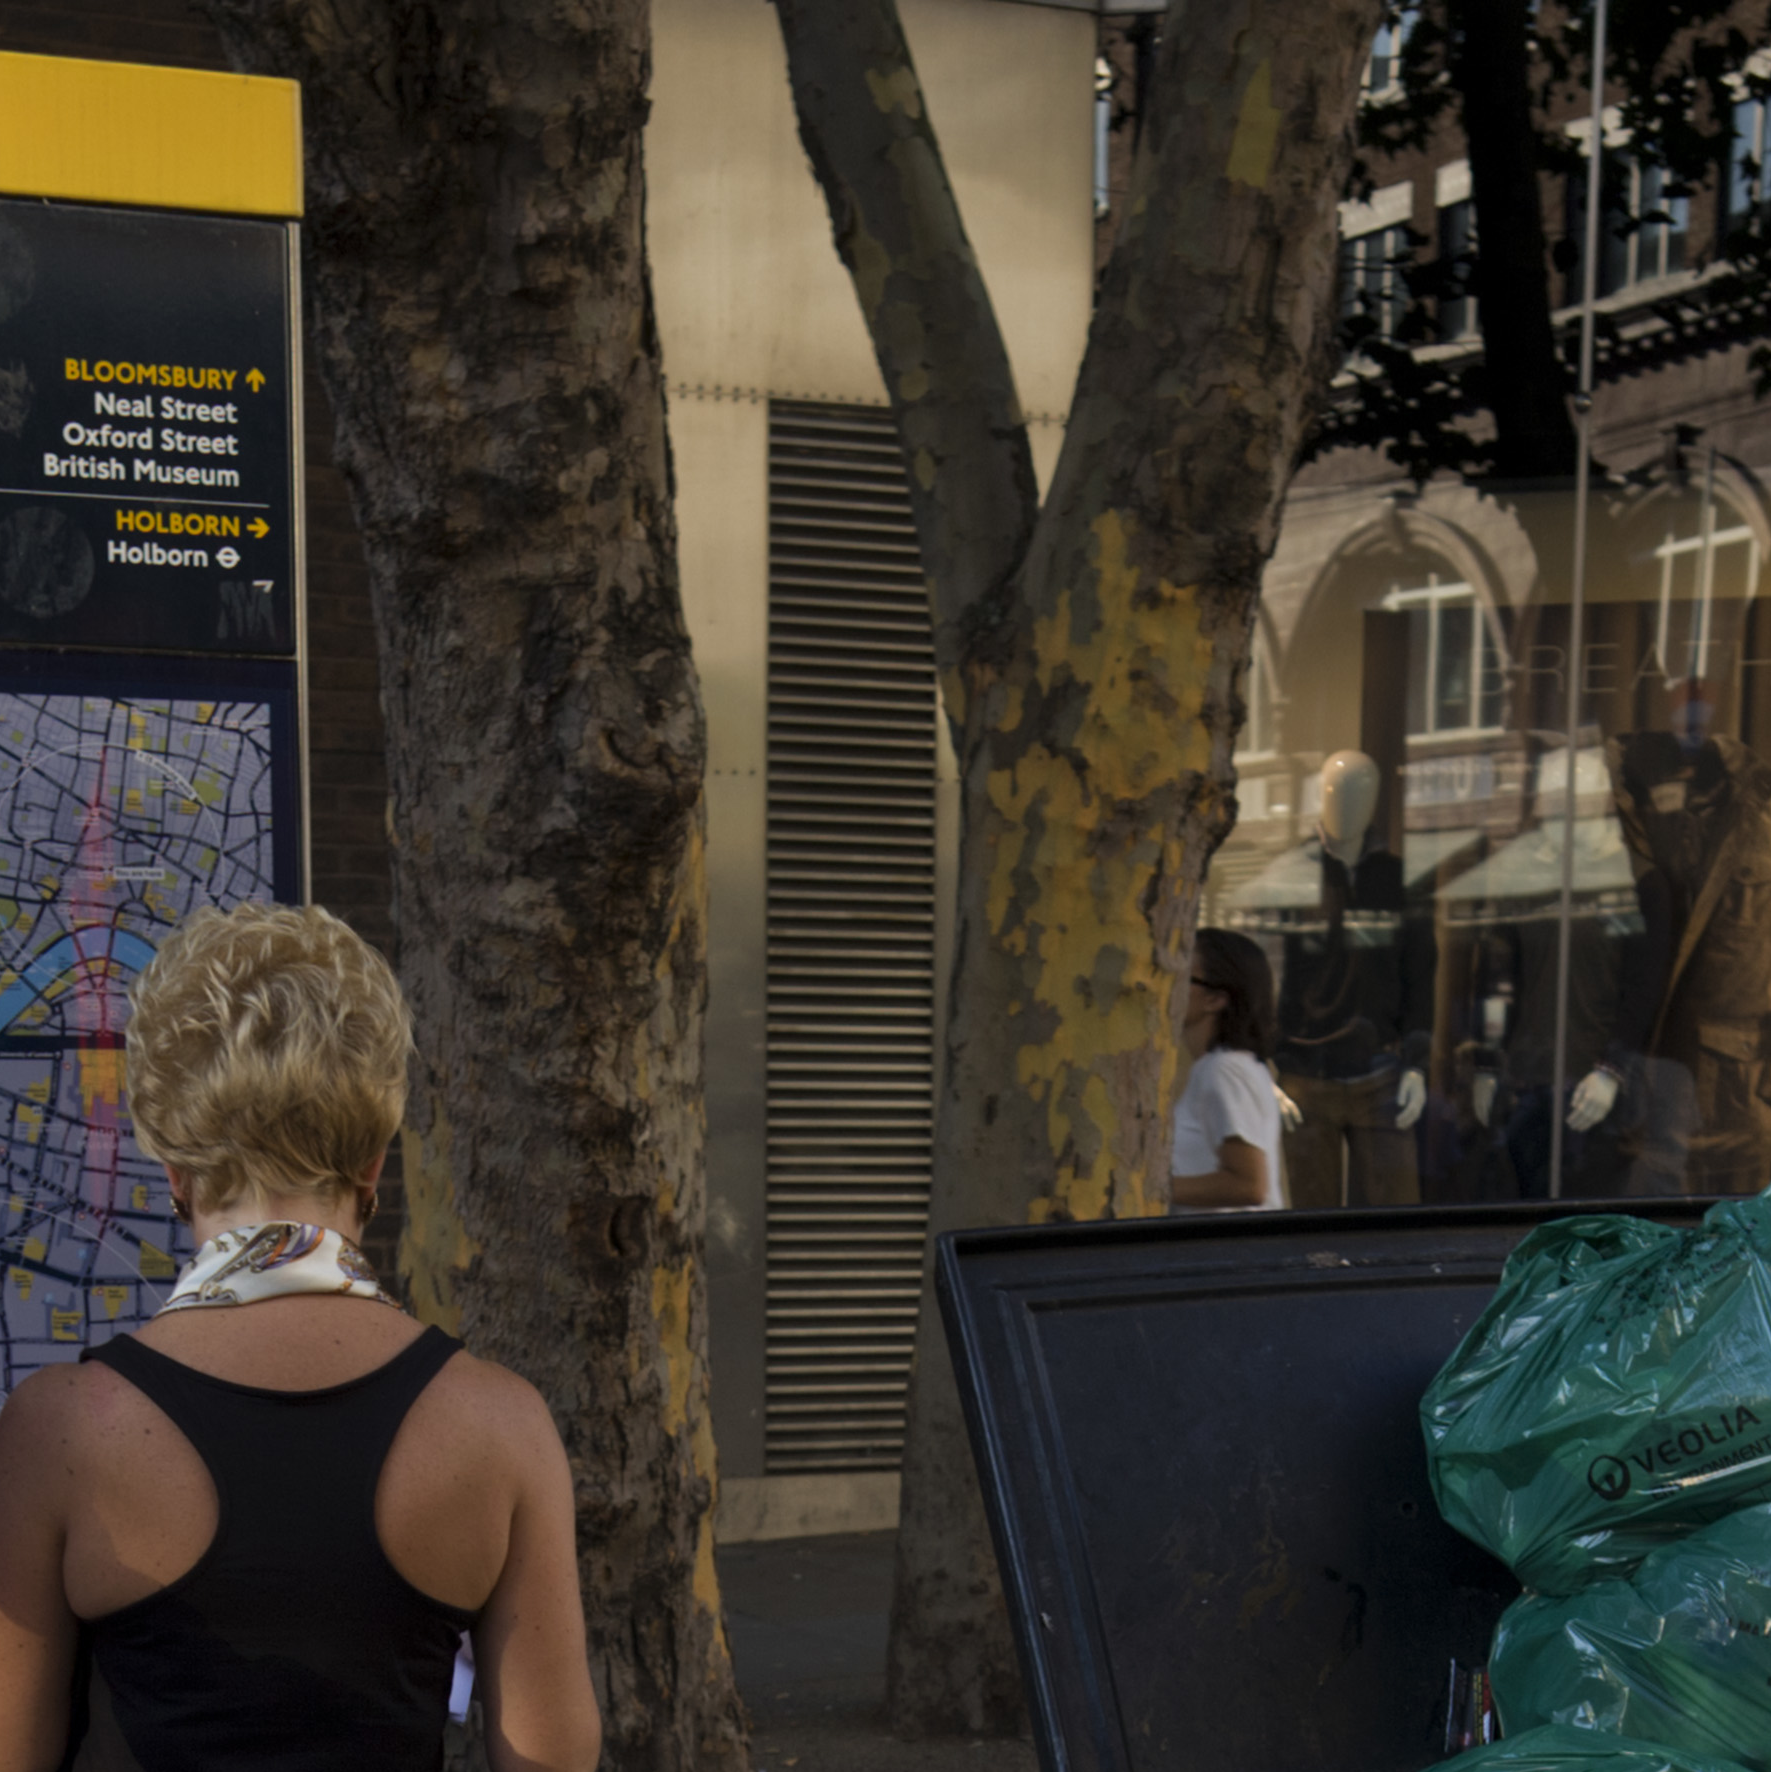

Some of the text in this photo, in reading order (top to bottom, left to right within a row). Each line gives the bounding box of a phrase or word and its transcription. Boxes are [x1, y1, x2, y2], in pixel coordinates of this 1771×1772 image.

[65, 358, 238, 391] BLOOMSBURY
[94, 392, 238, 424] Neal Street
[63, 423, 238, 456] Oxford Street
[44, 453, 240, 488] British Museum
[116, 511, 241, 539] HOLBORN
[108, 541, 209, 569] Holborn
[1631, 1404, 1761, 1473] VEOLIA
